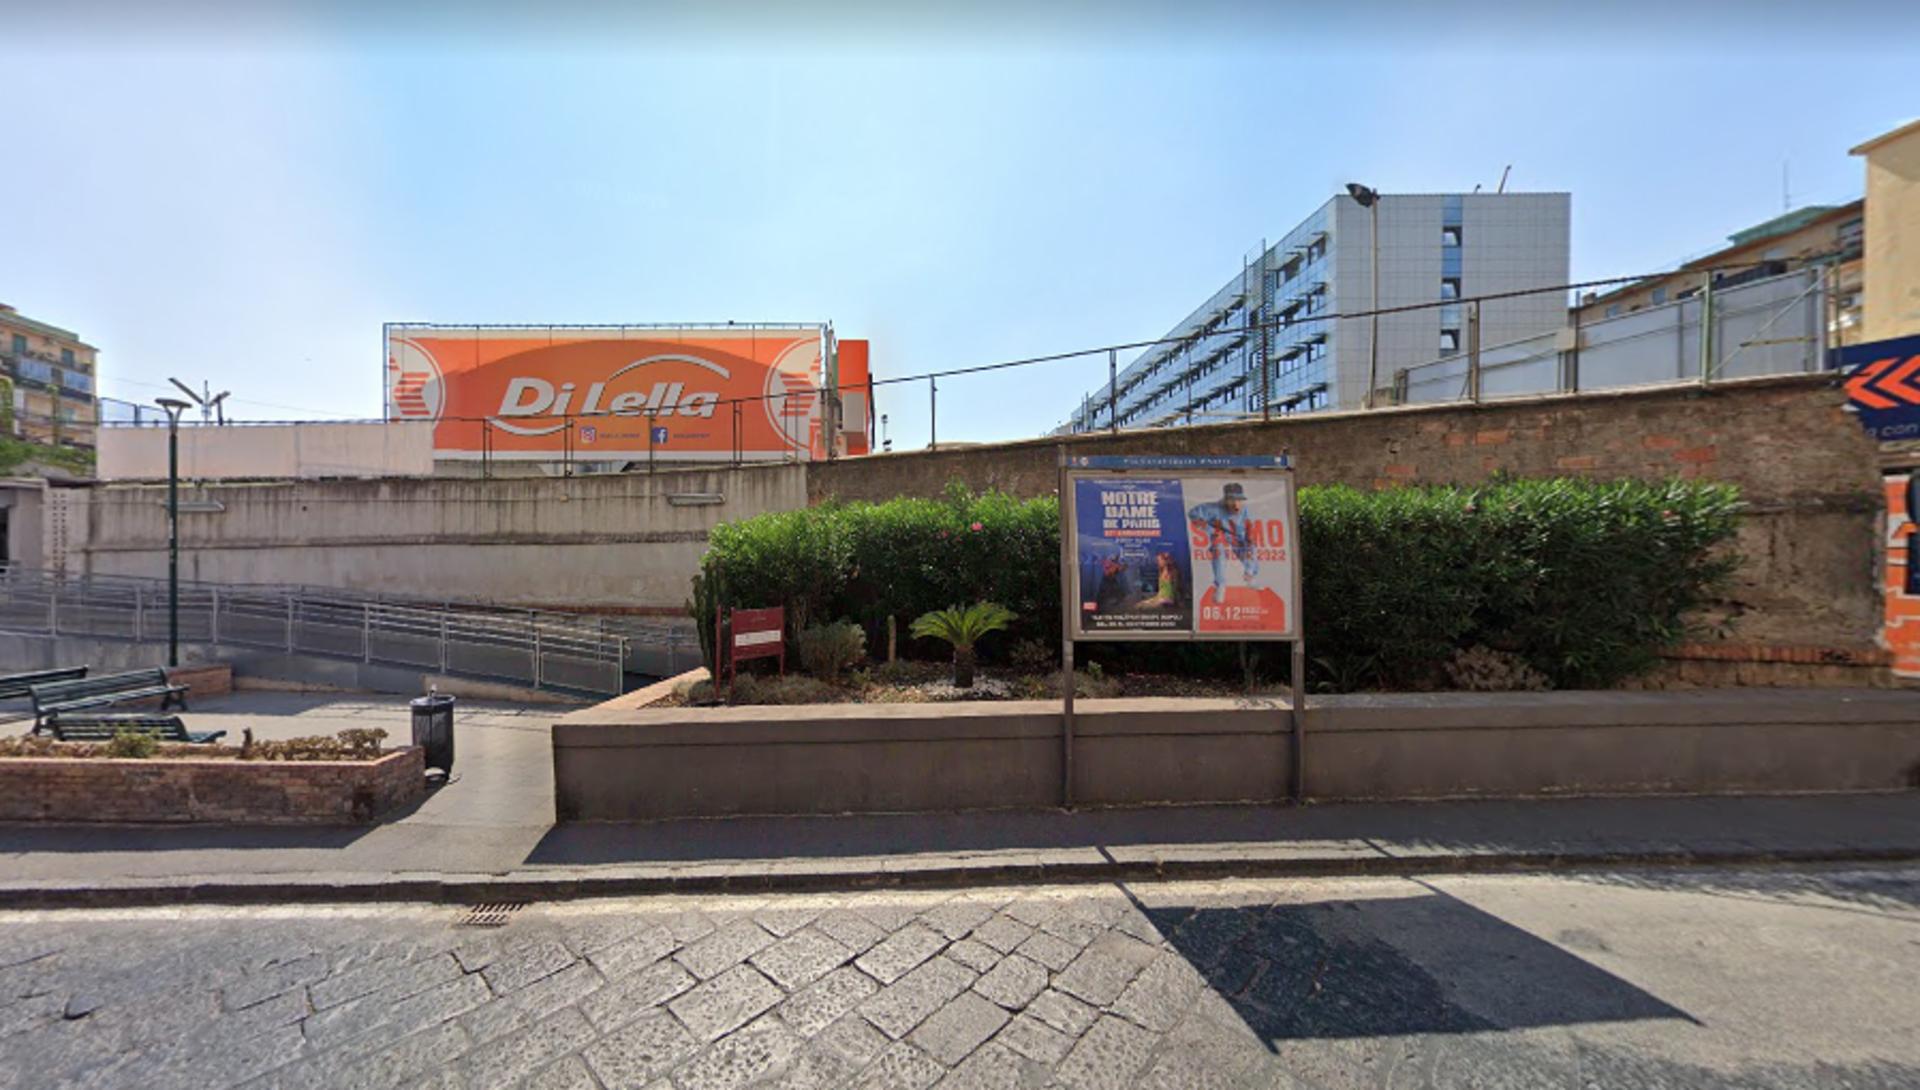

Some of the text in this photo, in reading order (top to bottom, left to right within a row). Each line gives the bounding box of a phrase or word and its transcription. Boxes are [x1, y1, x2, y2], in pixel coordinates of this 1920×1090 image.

[498, 377, 719, 418] Di Lella
[1101, 491, 1160, 505] NOTRE
[1121, 519, 1161, 529] PARIS
[1190, 519, 1283, 547] SALMO
[1257, 549, 1287, 561] 2022
[1203, 606, 1241, 621] 06.12
